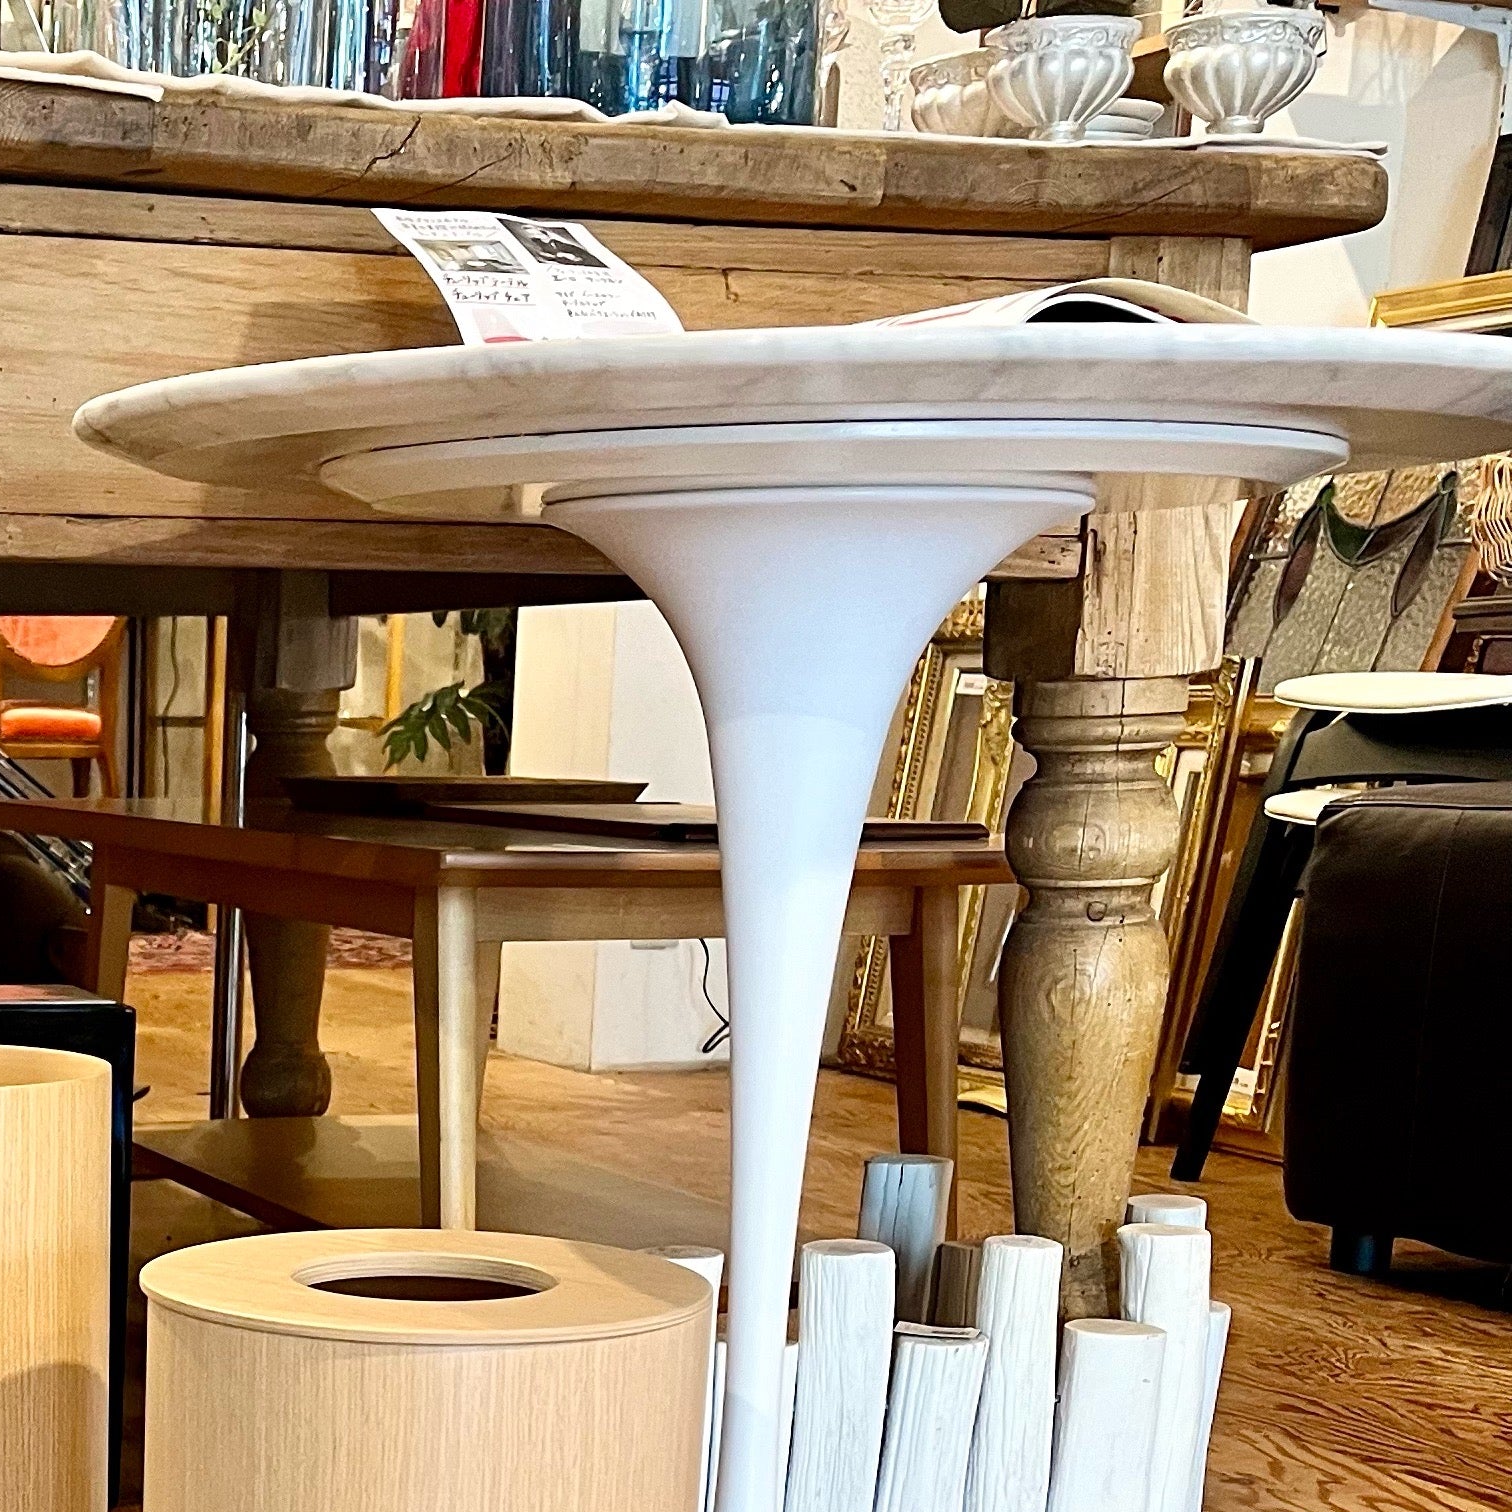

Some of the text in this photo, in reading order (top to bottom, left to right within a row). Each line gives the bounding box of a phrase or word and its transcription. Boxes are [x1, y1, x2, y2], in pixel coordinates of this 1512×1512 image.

[452, 287, 499, 300] チューリップ
